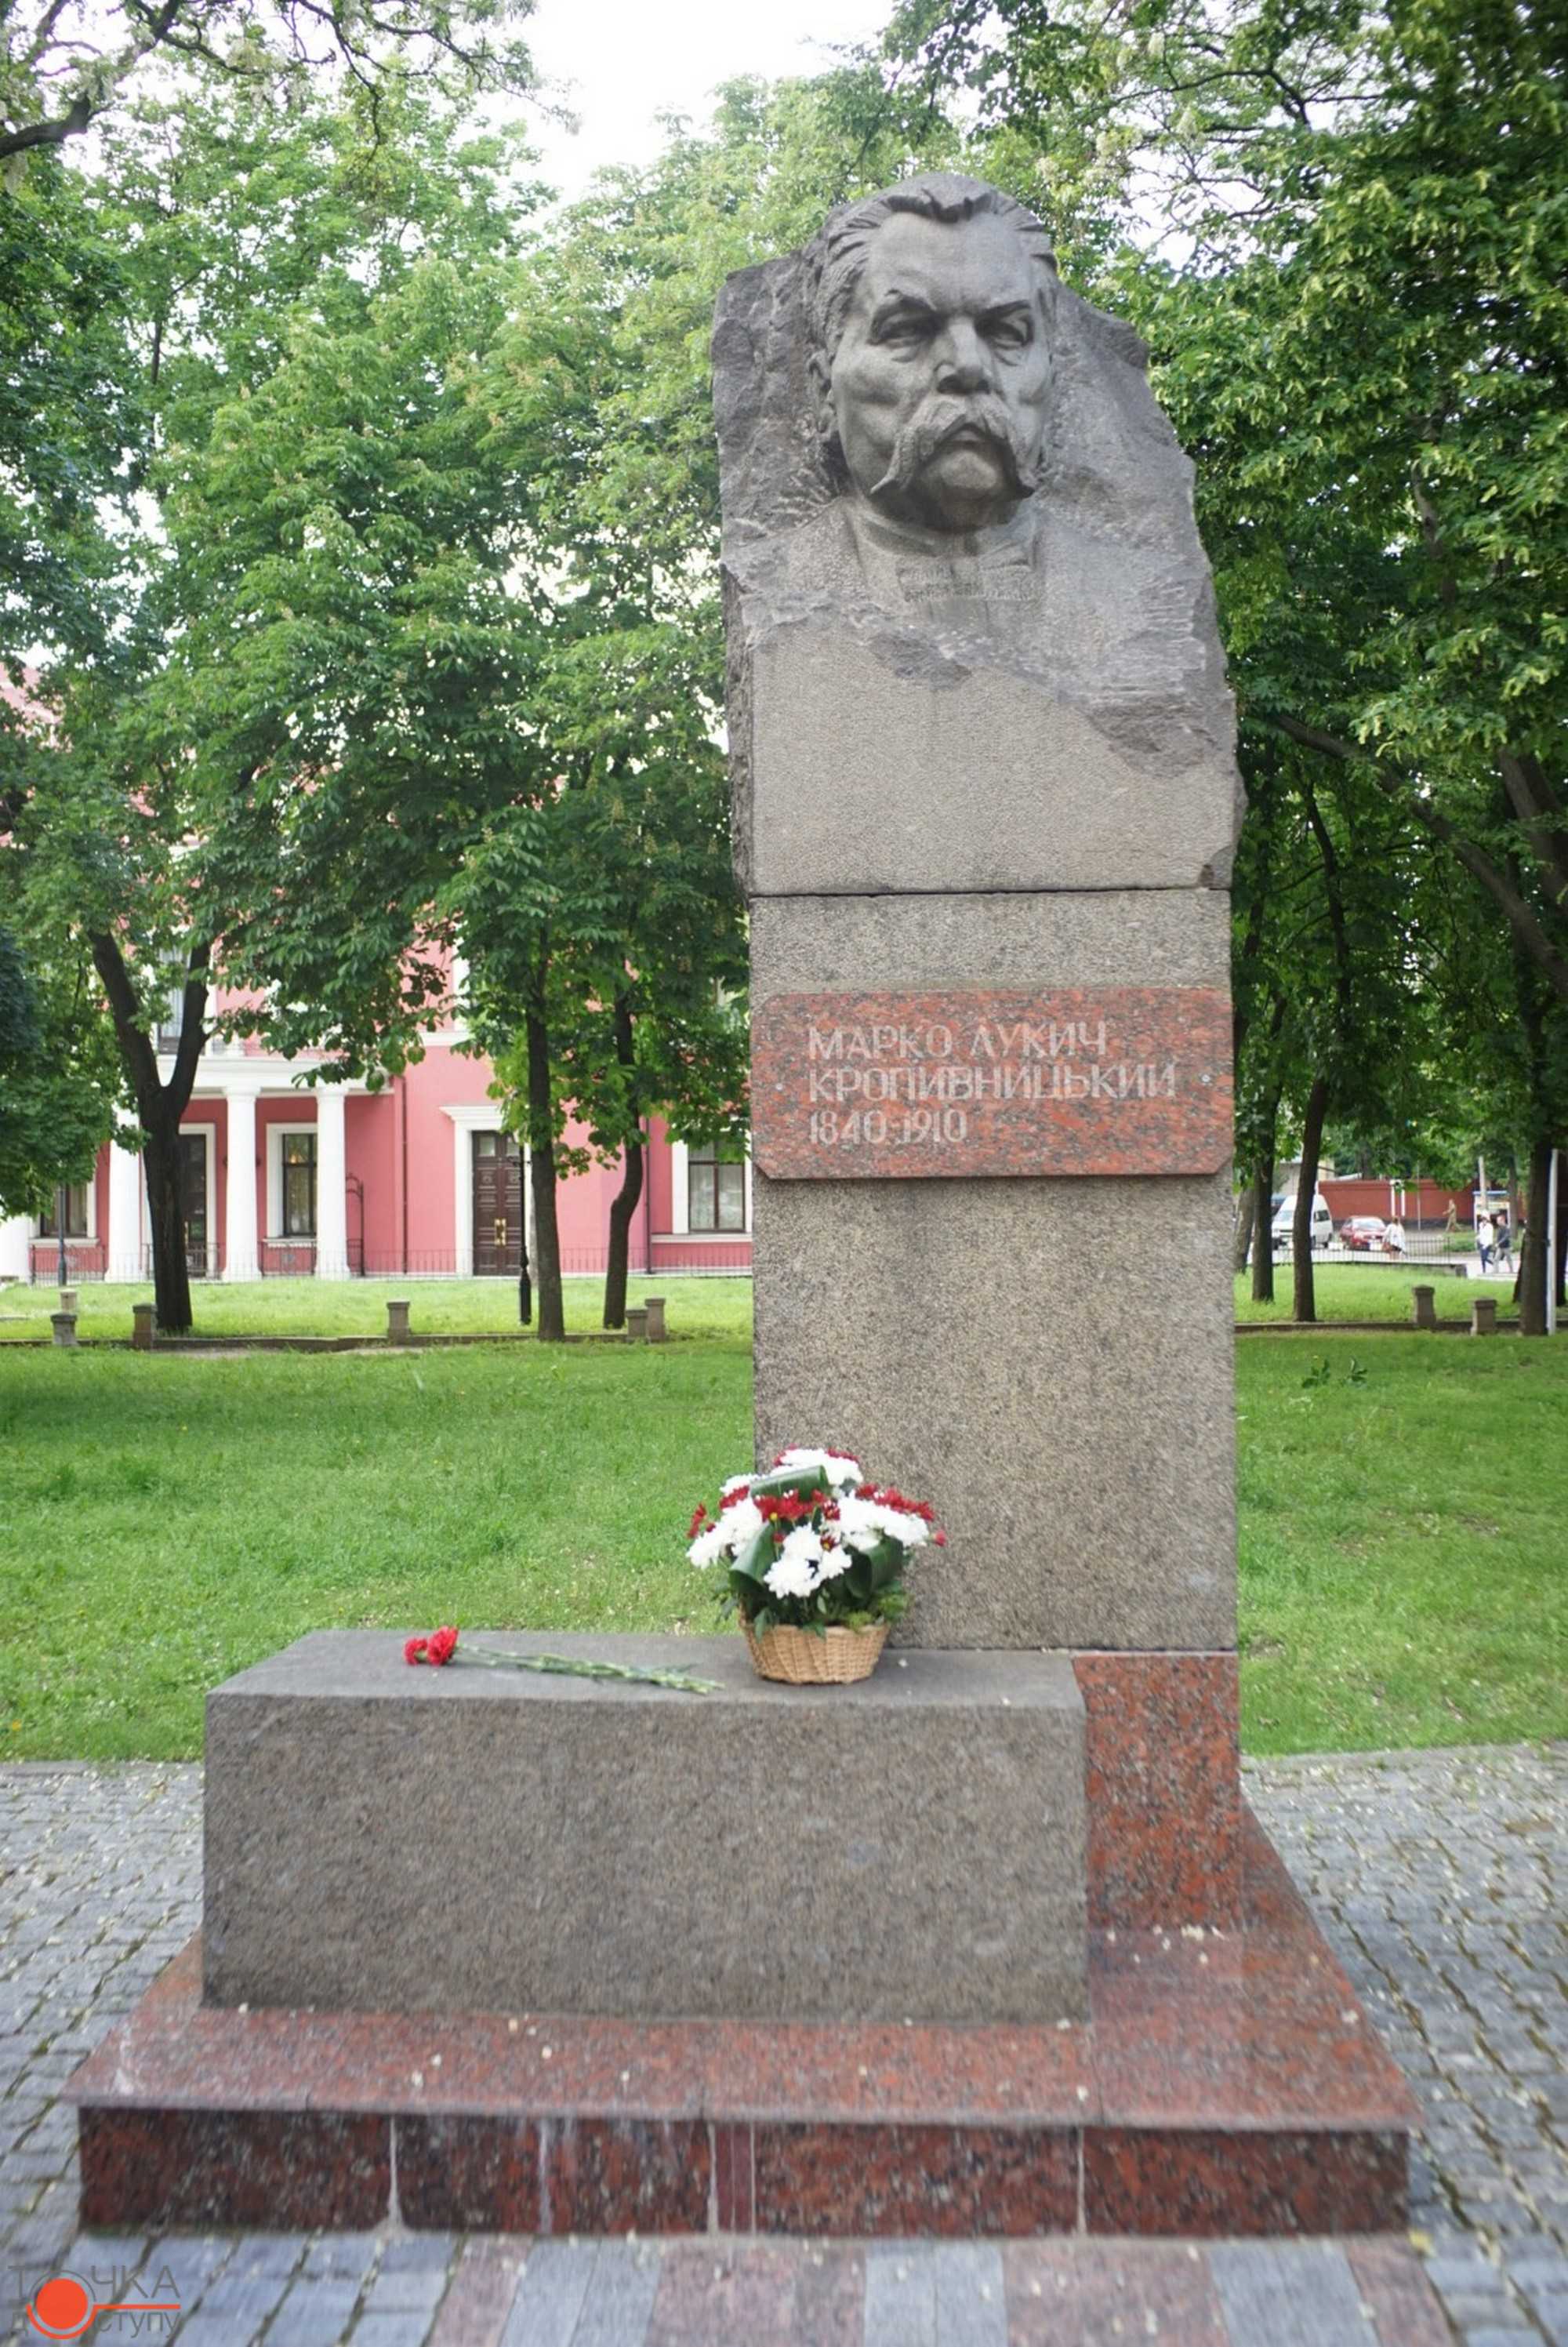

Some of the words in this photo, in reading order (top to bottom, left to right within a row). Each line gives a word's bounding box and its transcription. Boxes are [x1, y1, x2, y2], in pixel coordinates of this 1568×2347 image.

[808, 1026, 953, 1059] МАРКО
[970, 1023, 1106, 1056] ЛУКИЧ
[808, 1109, 967, 1146] 1840-1910
